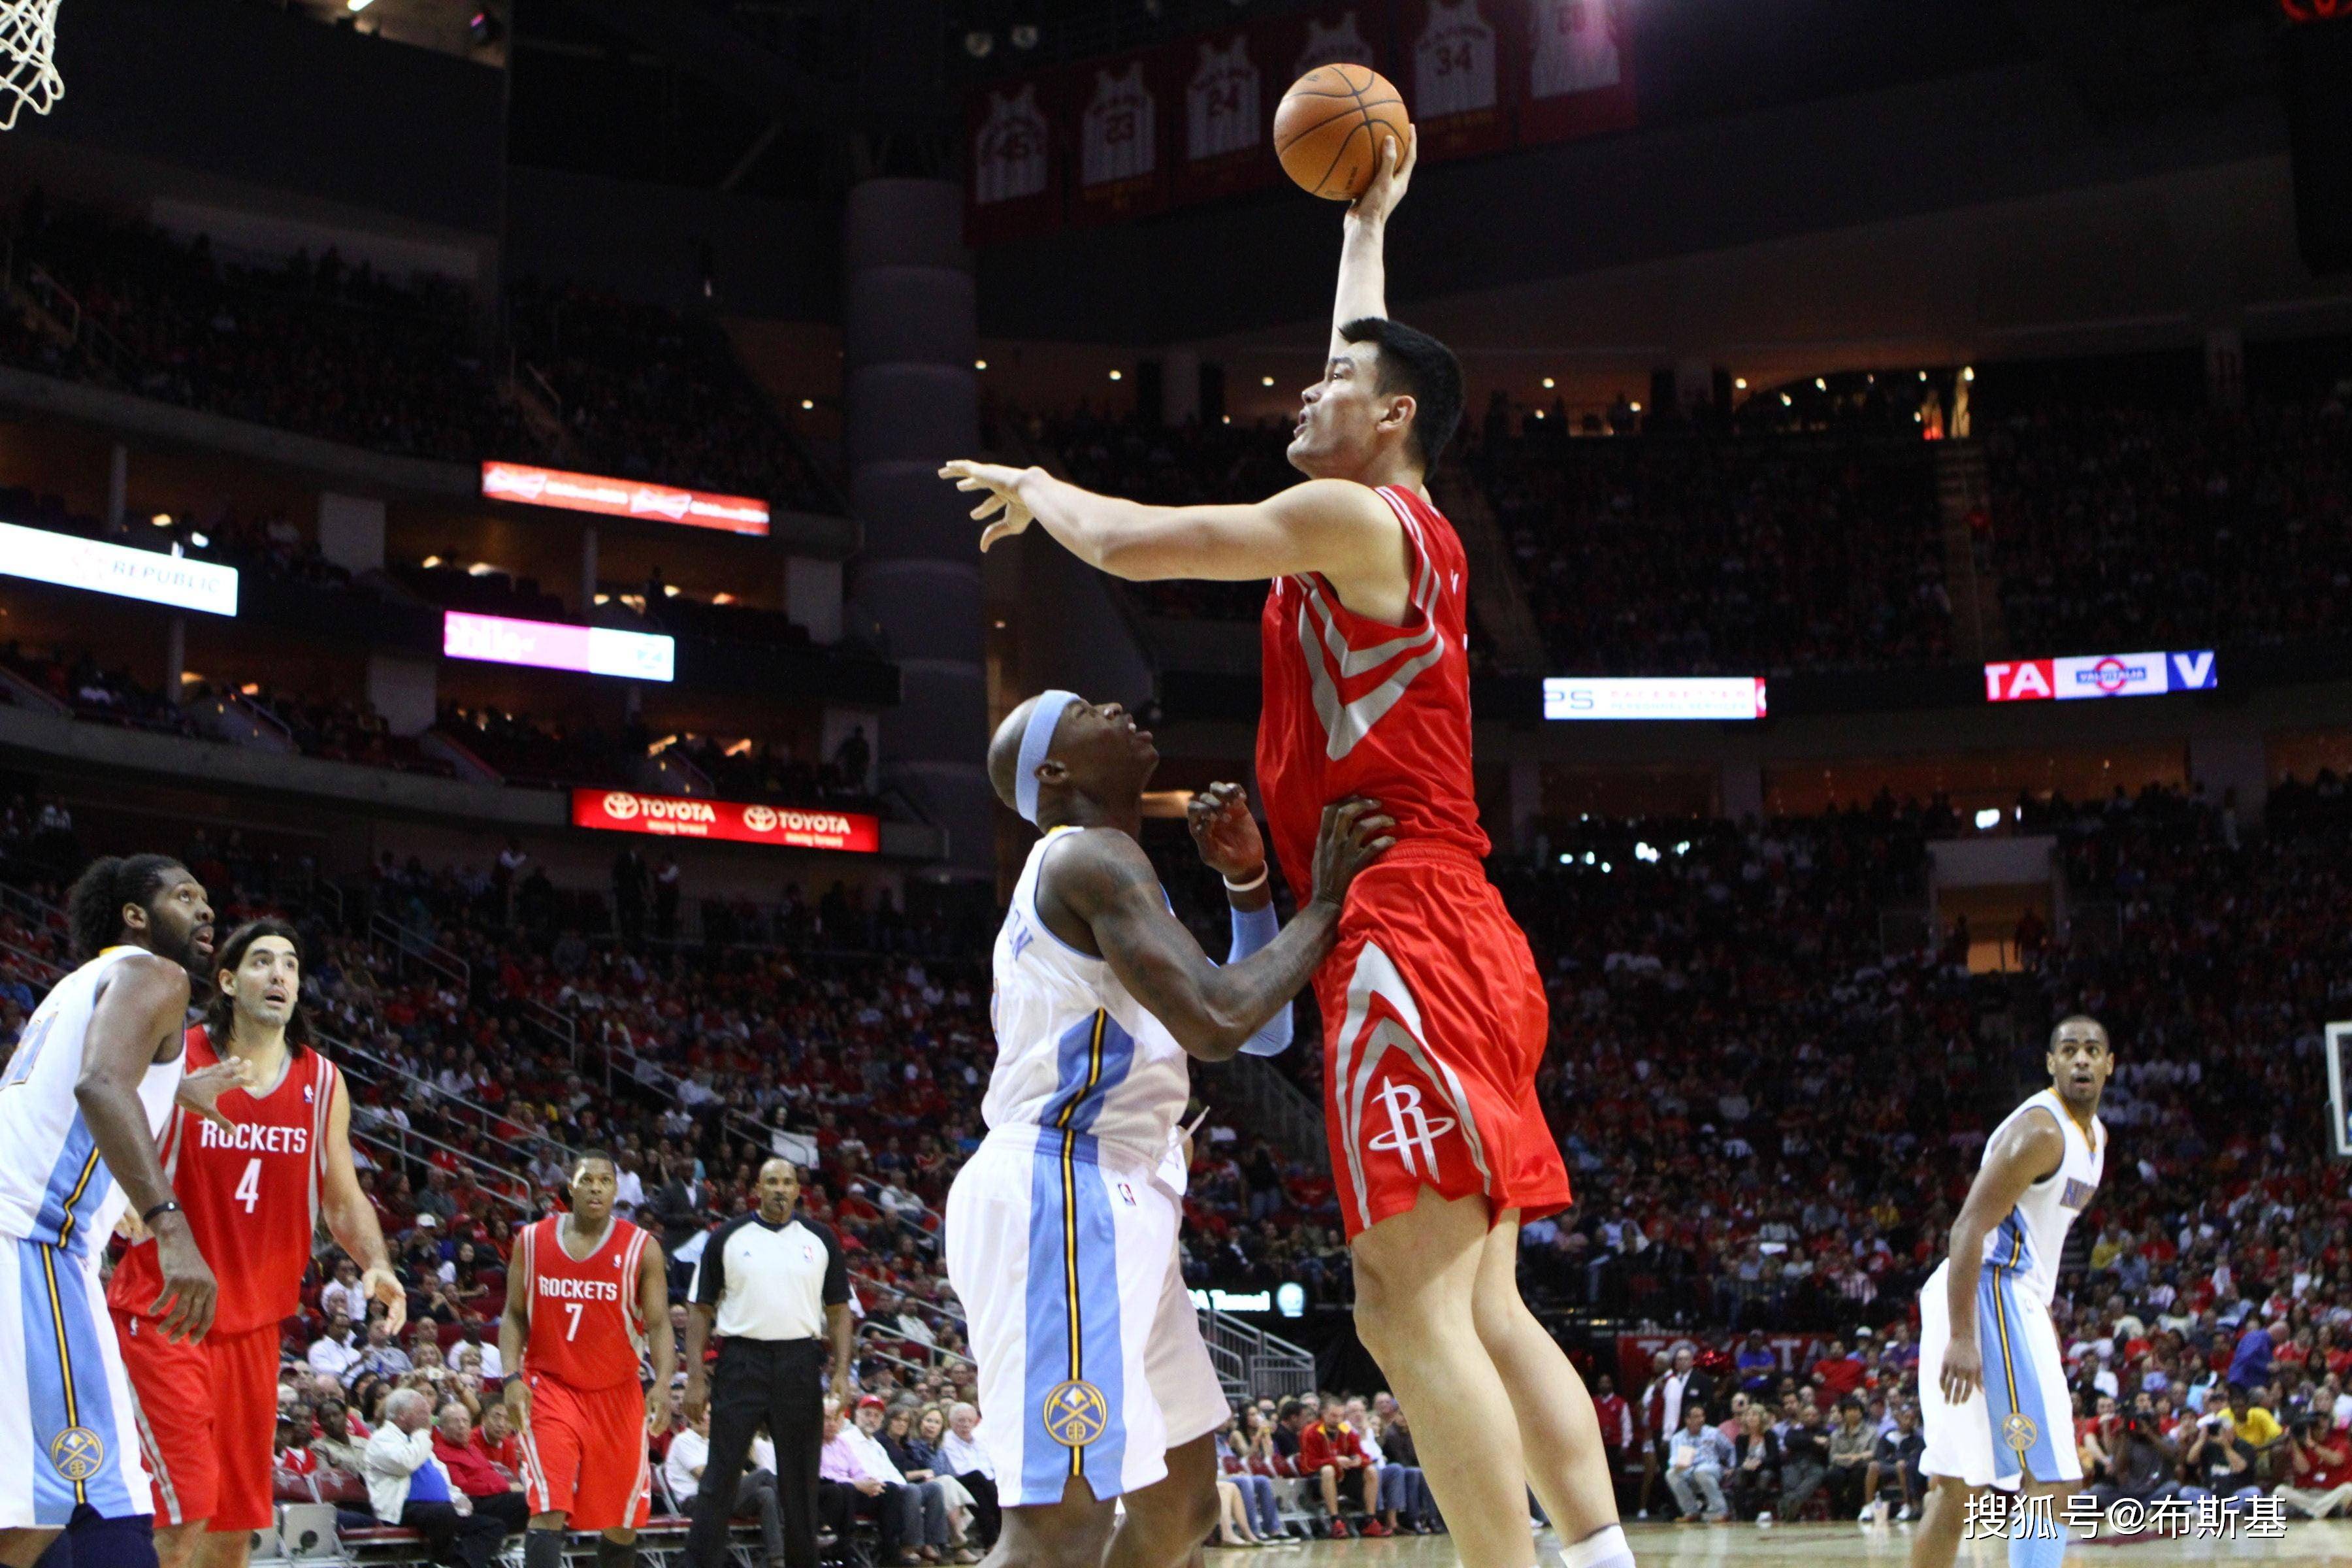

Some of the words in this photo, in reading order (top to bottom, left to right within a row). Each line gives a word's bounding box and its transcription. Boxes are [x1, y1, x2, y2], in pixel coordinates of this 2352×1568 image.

[112, 559, 221, 593] REPUBLIC
[640, 797, 716, 823] TOYOTA
[778, 810, 851, 835] TOYOTA
[198, 1118, 308, 1154] ROCKETS
[235, 1158, 262, 1214] 4
[538, 1274, 618, 1301] ROCKETS
[564, 1302, 584, 1342] 7
